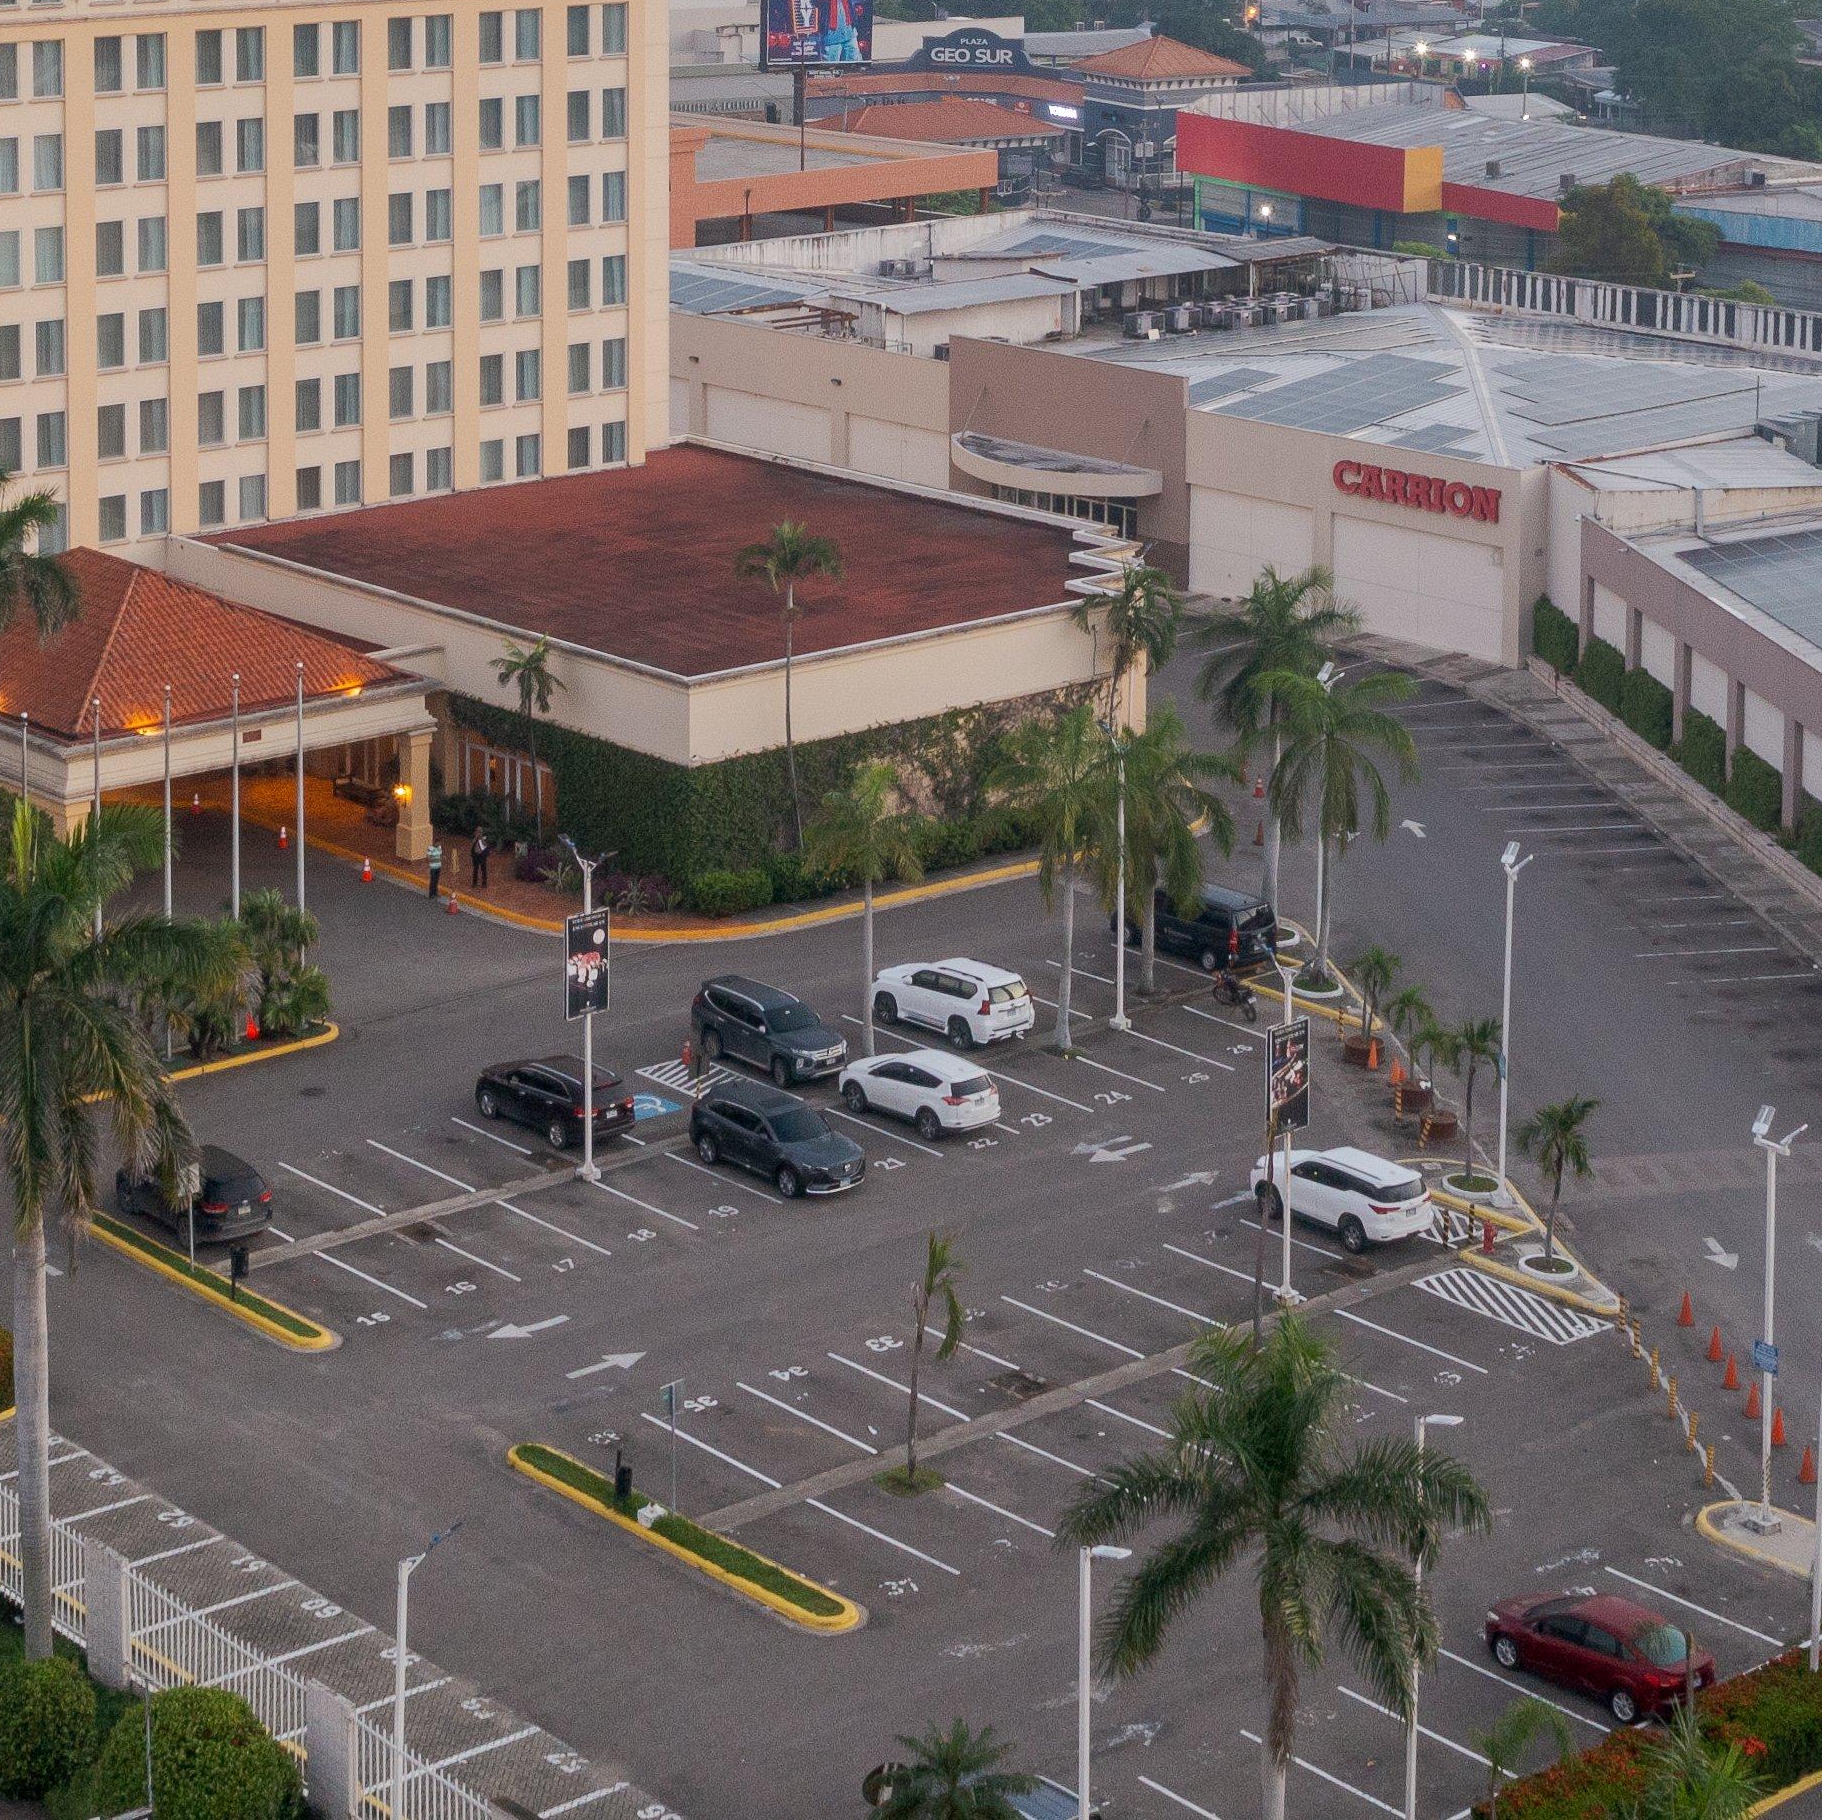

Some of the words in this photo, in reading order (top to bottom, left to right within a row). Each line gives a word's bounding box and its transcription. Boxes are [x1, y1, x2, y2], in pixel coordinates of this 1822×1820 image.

[931, 47, 970, 63] GEO
[975, 49, 1013, 64] SUR
[1333, 459, 1502, 524] CARRION
[1094, 1090, 1132, 1105] 24
[1020, 1113, 1053, 1128] 23
[967, 1138, 999, 1150] 22
[873, 1157, 907, 1171] 21
[708, 1205, 740, 1218] 19
[628, 1228, 657, 1242] 18
[551, 1258, 575, 1273] 17
[445, 1281, 478, 1295] 16
[356, 1312, 391, 1326] 15
[865, 1336, 903, 1351] 33
[768, 1366, 809, 1381] 34
[684, 1395, 718, 1412] 35
[157, 1508, 195, 1528] 62
[231, 1555, 267, 1573] 61
[300, 1598, 343, 1618] 60
